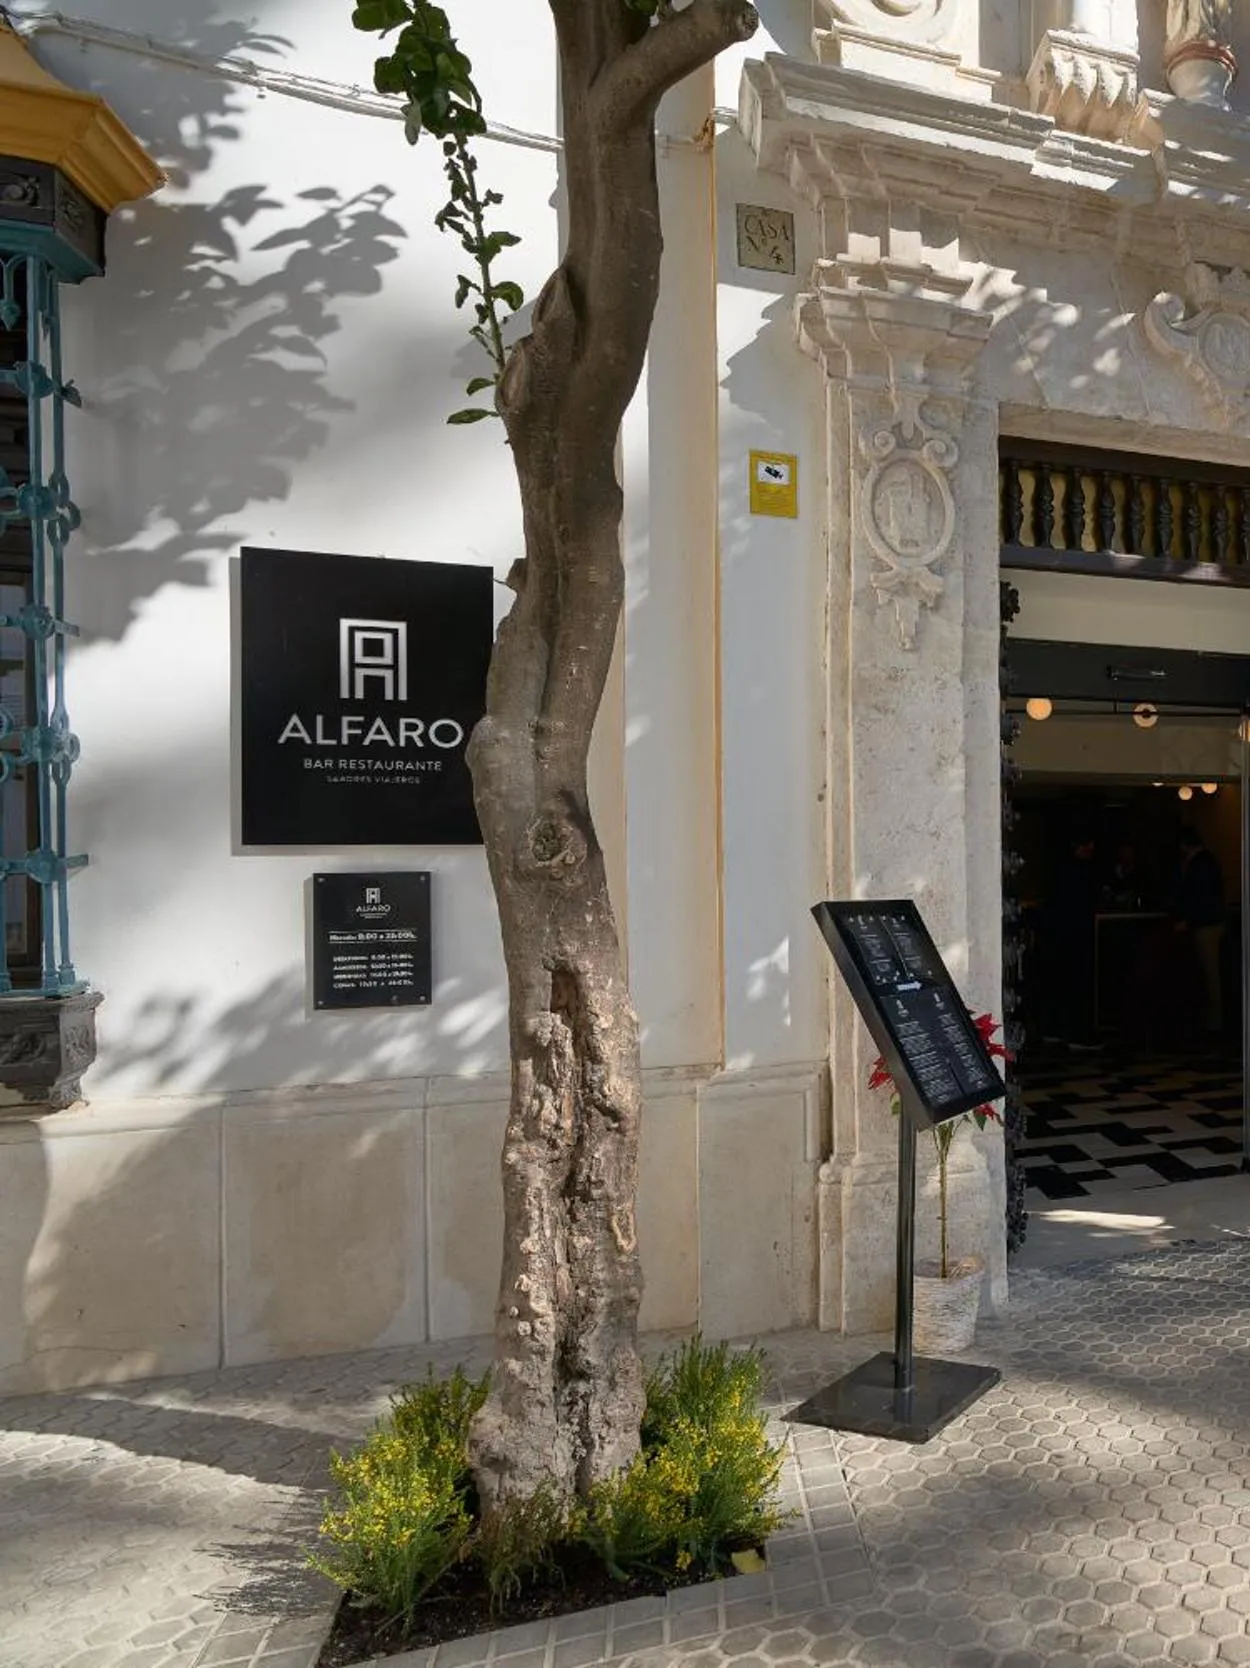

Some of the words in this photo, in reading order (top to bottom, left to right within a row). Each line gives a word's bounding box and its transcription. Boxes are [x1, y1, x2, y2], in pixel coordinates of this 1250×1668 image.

[744, 214, 790, 241] CASA
[277, 713, 464, 748] ALFARO
[304, 758, 332, 770] BAR
[338, 758, 442, 772] RESTAURANTE
[356, 904, 391, 913] ALFARO
